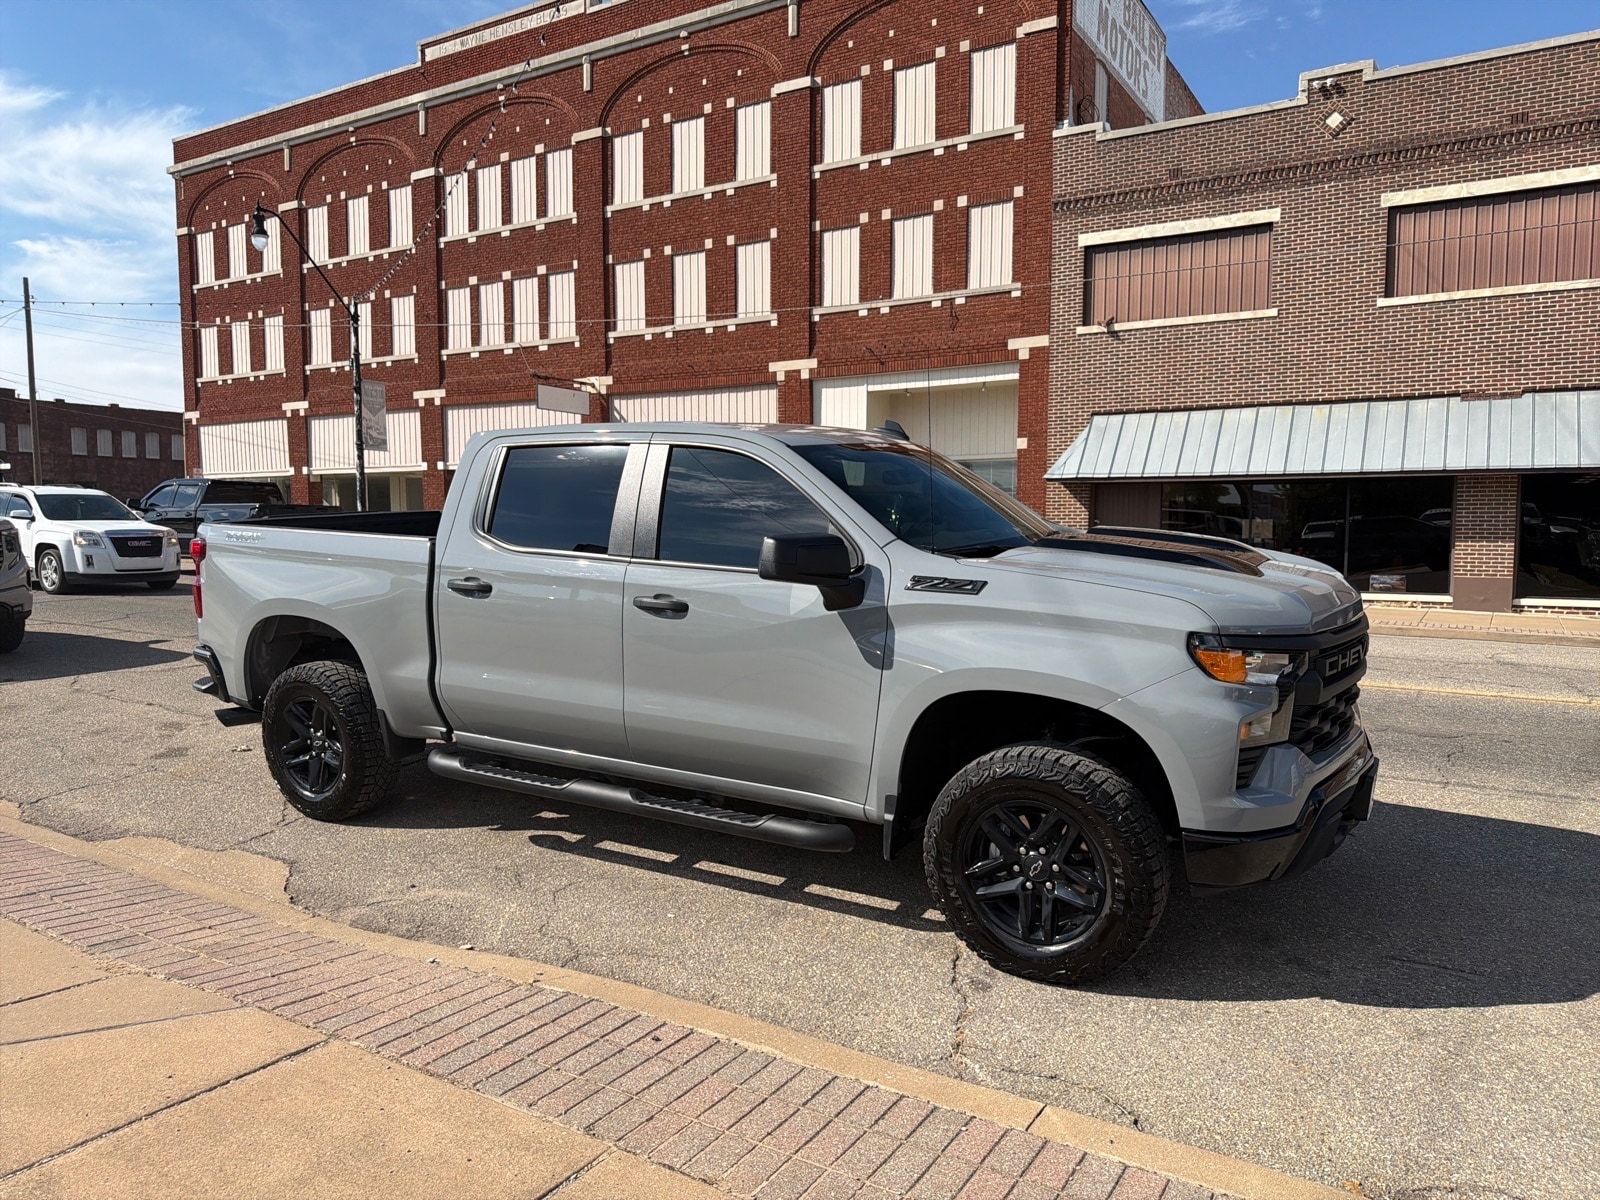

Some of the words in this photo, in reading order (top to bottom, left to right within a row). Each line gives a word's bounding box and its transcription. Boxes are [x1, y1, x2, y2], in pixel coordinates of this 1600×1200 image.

[459, 31, 487, 49] WAYNE
[489, 15, 534, 39] HENSLEY
[1097, 0, 1150, 100] MOTORS
